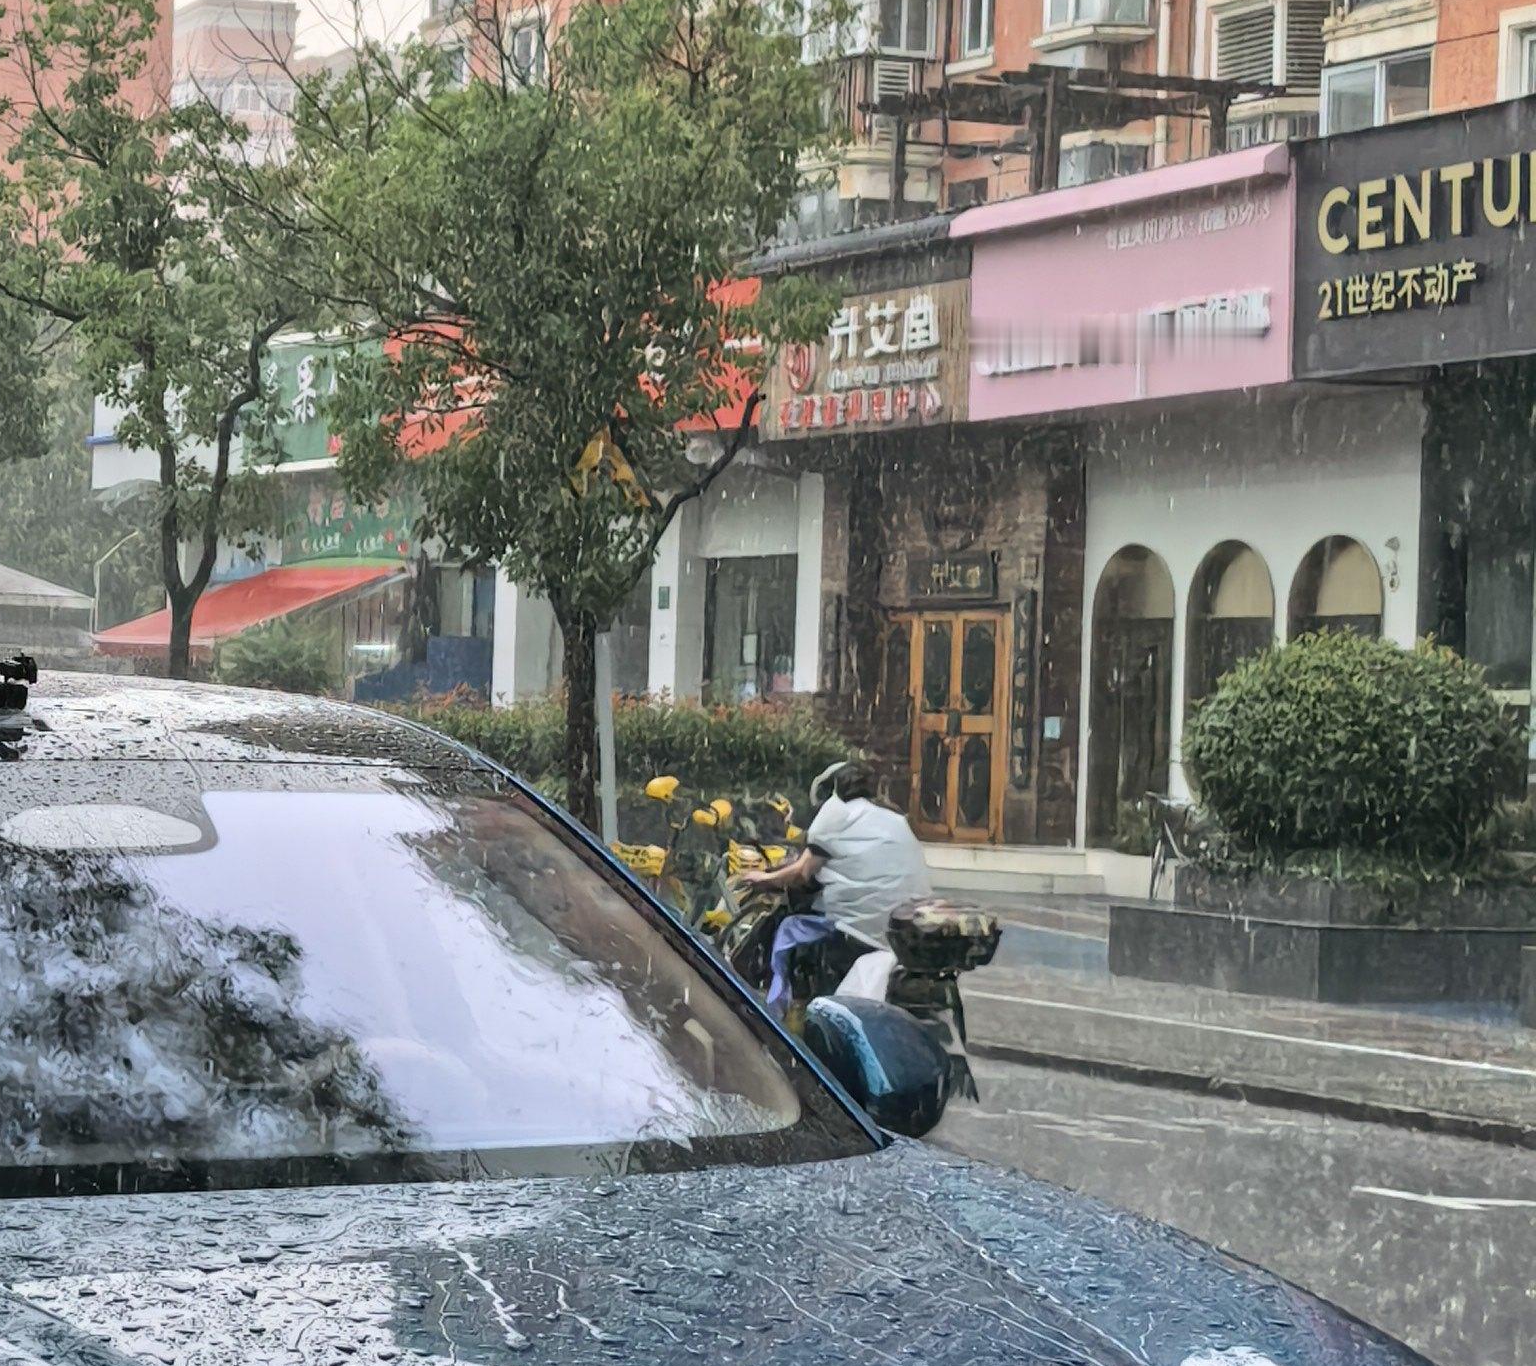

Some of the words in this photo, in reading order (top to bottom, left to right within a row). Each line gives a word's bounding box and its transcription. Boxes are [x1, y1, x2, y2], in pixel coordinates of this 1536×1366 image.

[1318, 150, 1536, 255] CENTU
[1318, 258, 1477, 321] 21世纪不动产
